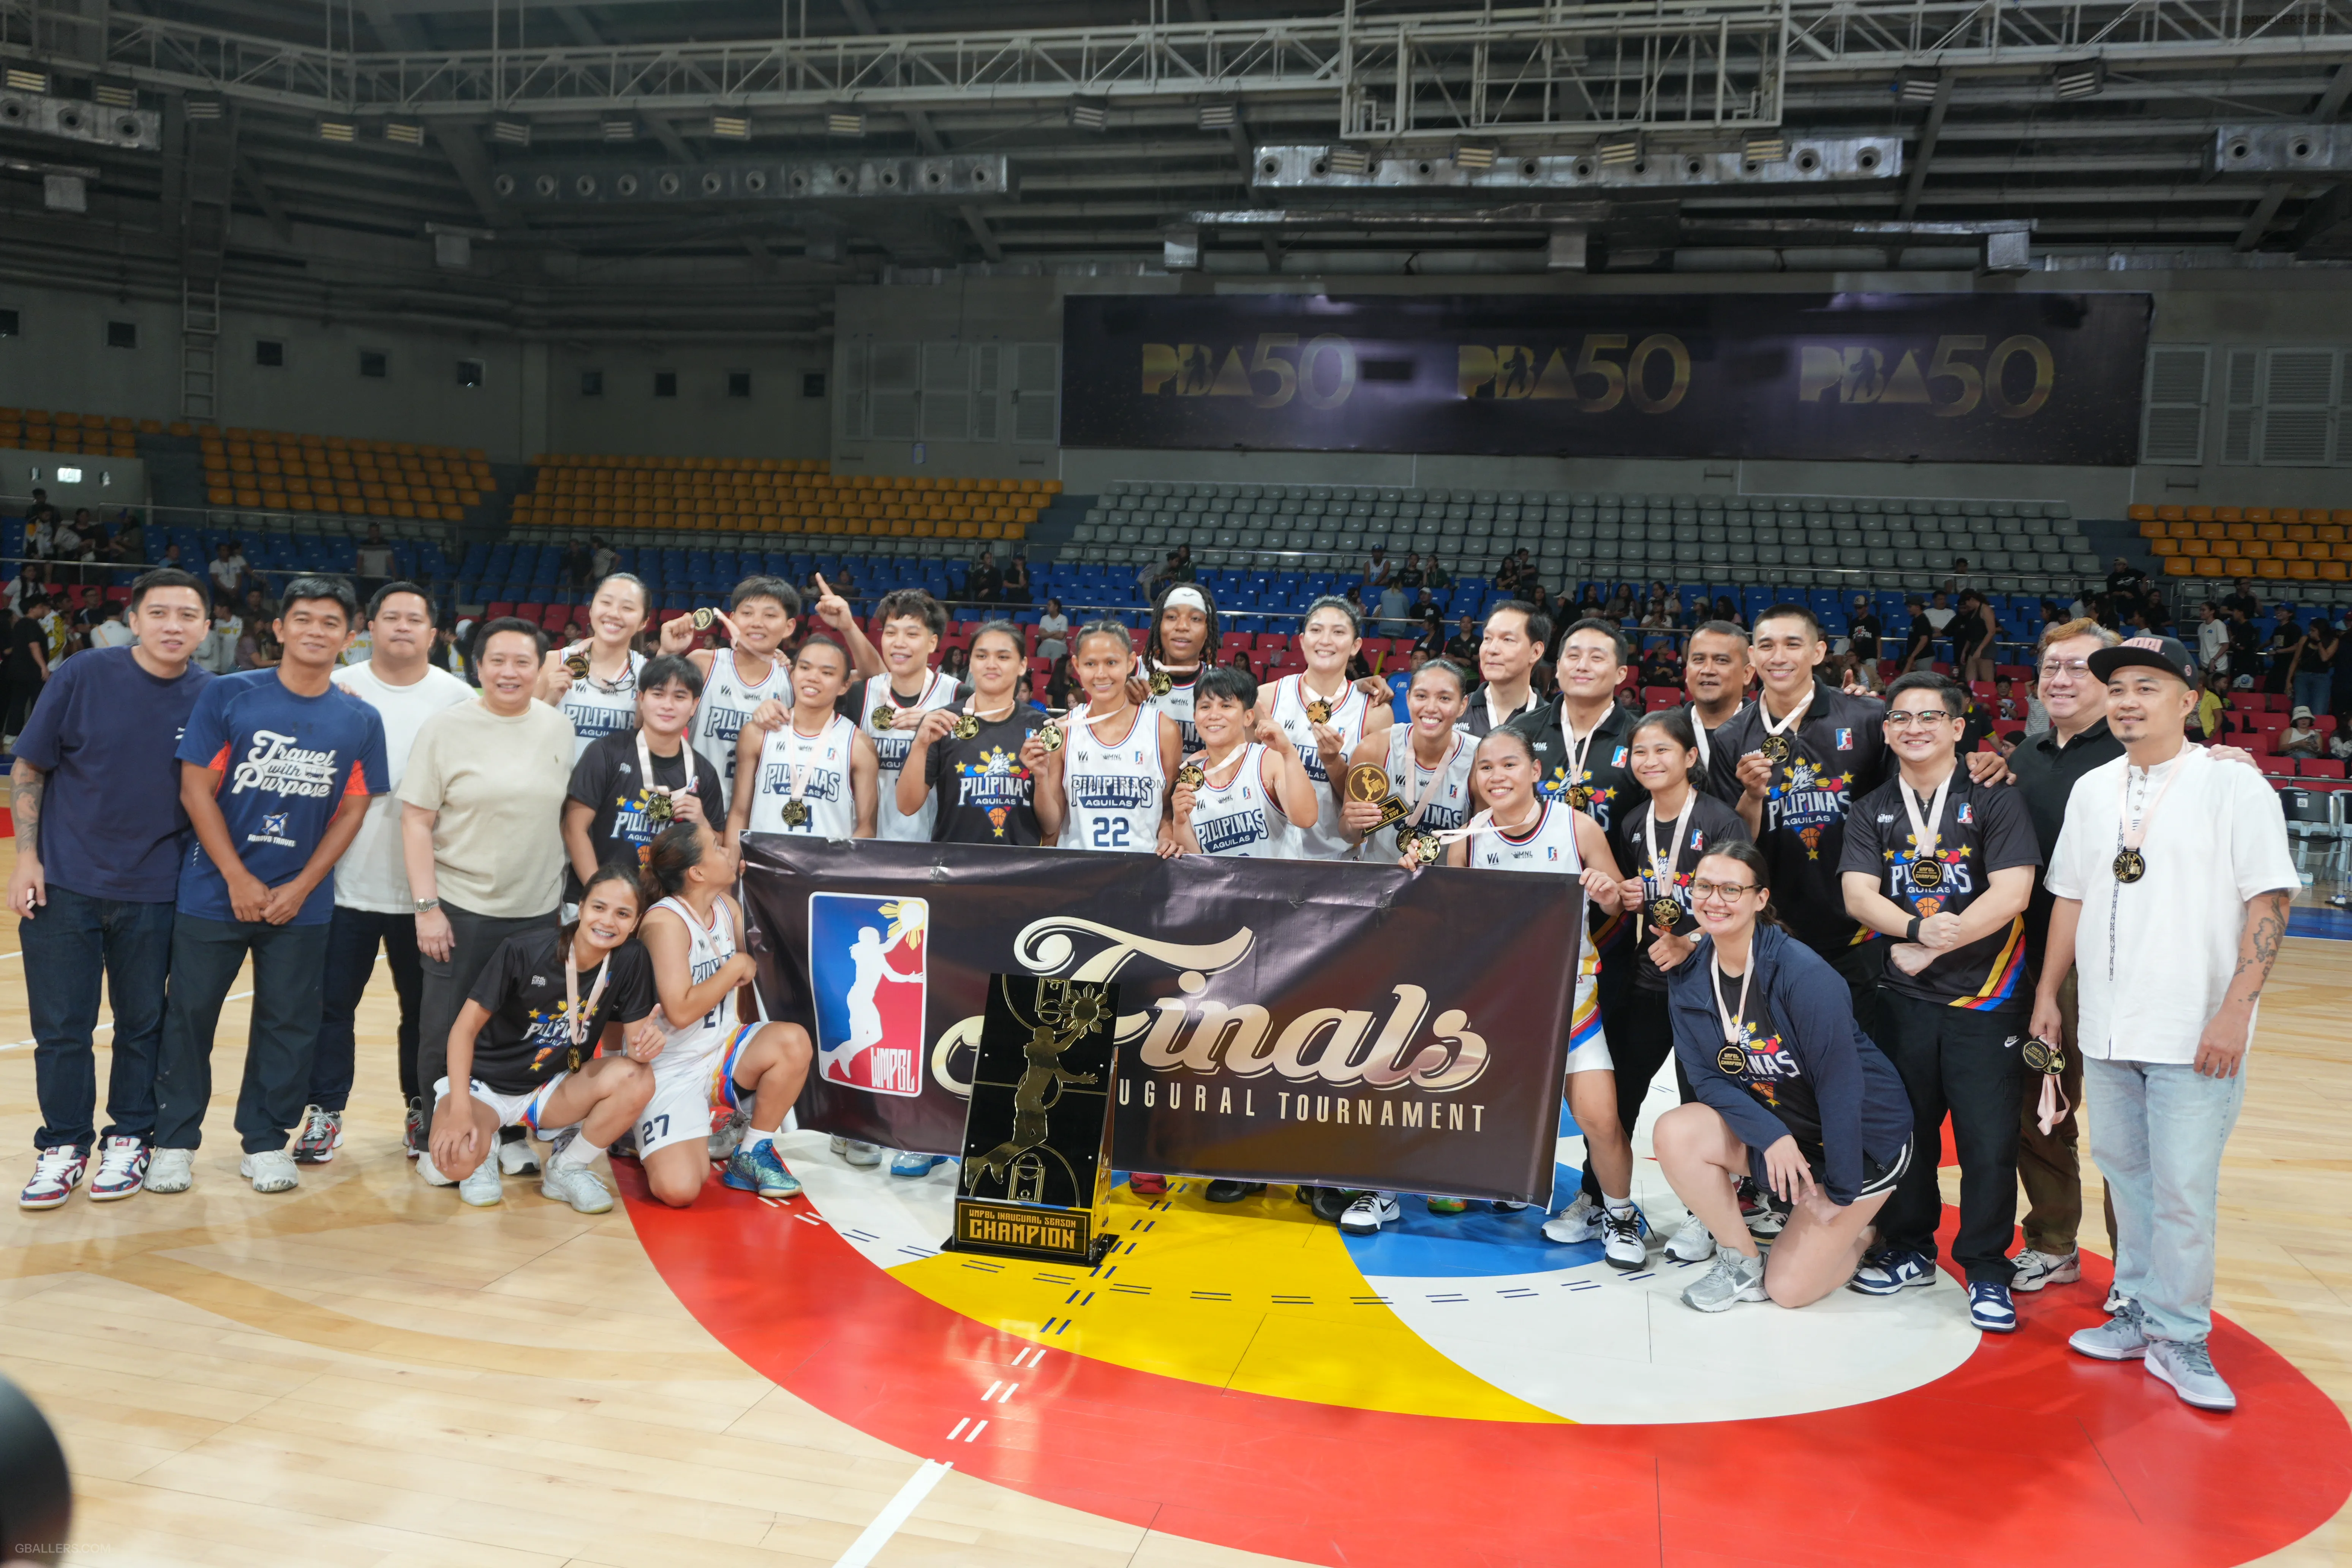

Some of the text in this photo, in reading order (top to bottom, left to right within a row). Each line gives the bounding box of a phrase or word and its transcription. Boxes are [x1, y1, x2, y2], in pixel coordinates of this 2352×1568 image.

[565, 703, 635, 730] PILIPINA
[704, 706, 753, 737] PILIP
[248, 730, 337, 767] Travel
[231, 762, 331, 798] Purpose
[267, 763, 302, 777] with
[1072, 775, 1152, 808] PILIPINAS
[1768, 790, 1851, 832] PILIPINAS
[1783, 815, 1831, 826] AGUILAS
[628, 834, 652, 842] AGUIL
[1092, 817, 1130, 847] 22
[1194, 809, 1269, 854] PILIPINAS
[1212, 835, 1250, 850] AGUILAS
[932, 916, 1491, 1094] Finals
[870, 1047, 915, 1091] WMPBL
[1278, 1092, 1485, 1132] TOURNAMENT
[642, 1114, 669, 1147] 27
[969, 1209, 1076, 1228] WMPBL INAUGURAL SEASON
[969, 1219, 1075, 1249] CHAMPION
